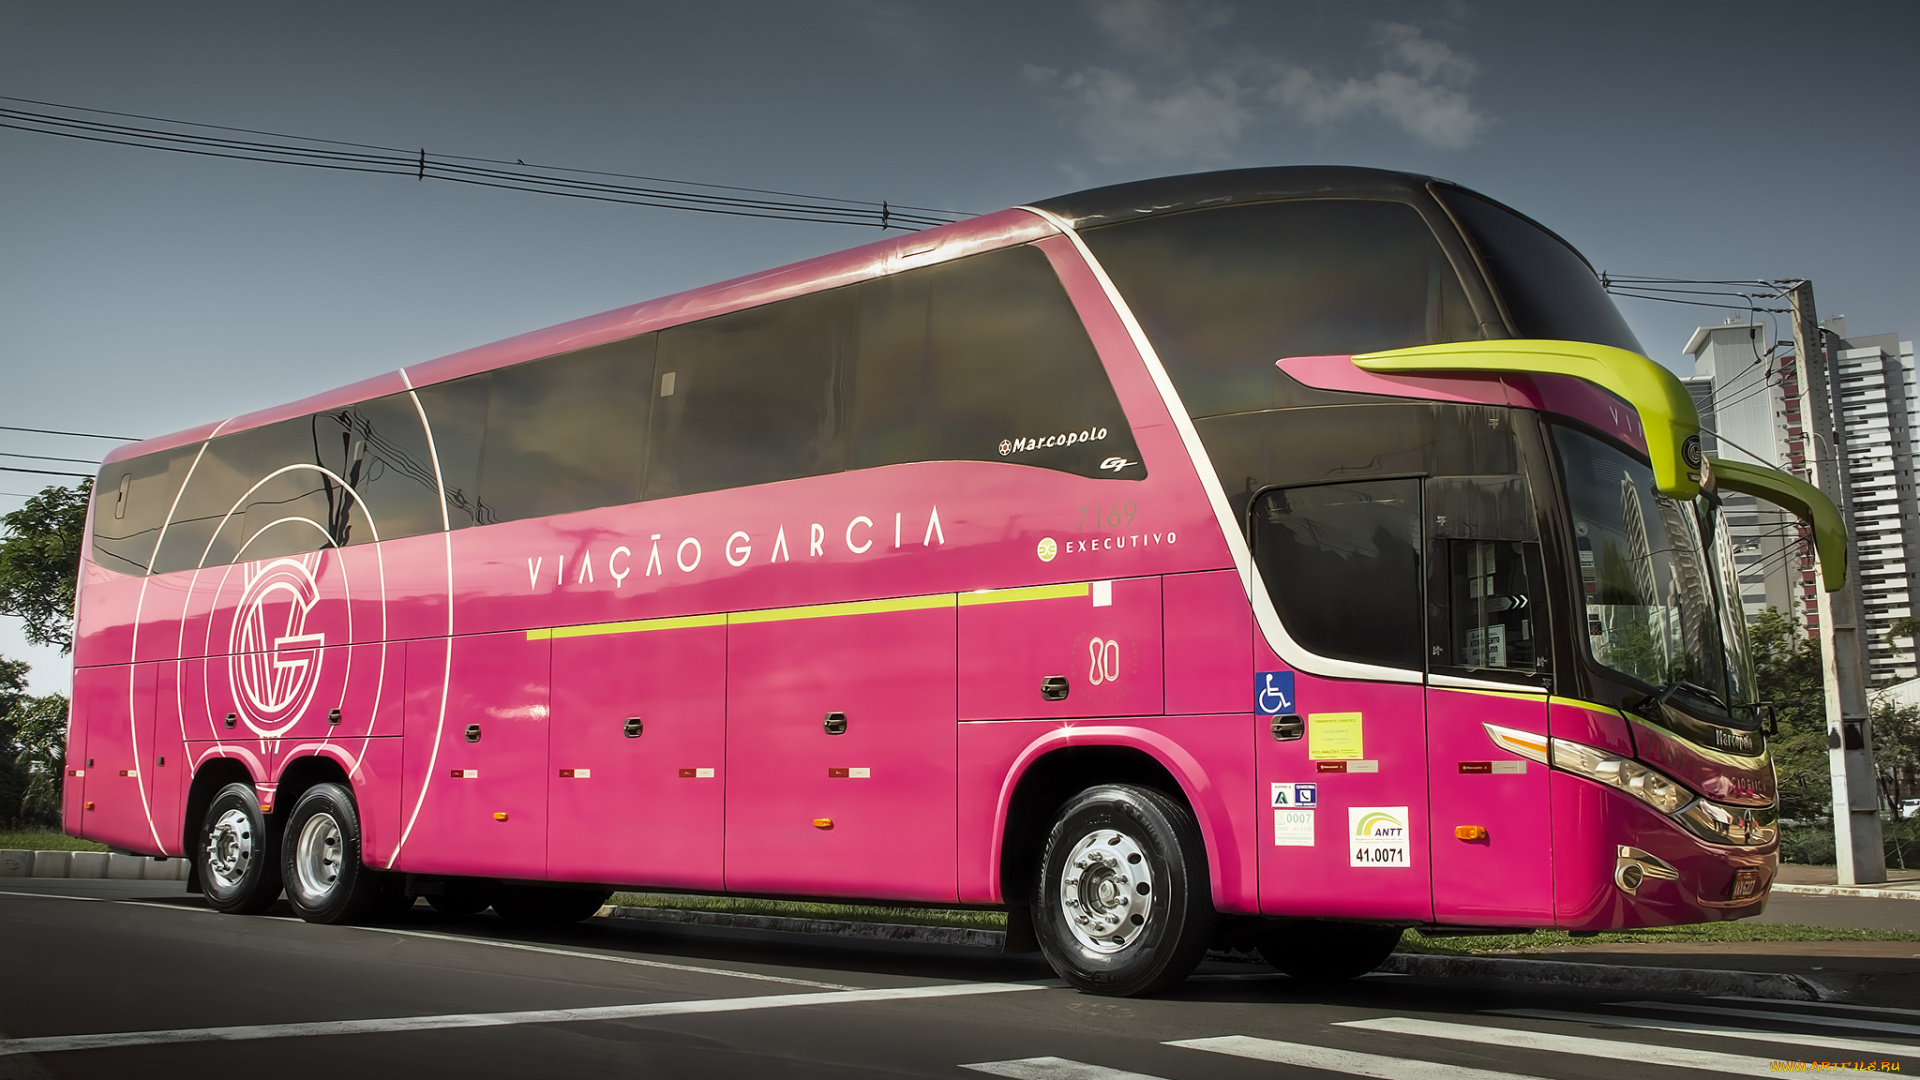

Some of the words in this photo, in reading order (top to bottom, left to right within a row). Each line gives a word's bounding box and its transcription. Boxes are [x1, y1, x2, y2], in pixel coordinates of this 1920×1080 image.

[1012, 426, 1107, 453] Marcopolo
[1076, 501, 1137, 532] 7169
[725, 504, 945, 567] GARCIA
[1065, 532, 1177, 553] EXECUTIVO
[1643, 732, 1684, 770] 7169
[1286, 813, 1312, 824] 0007
[1374, 828, 1403, 837] ANTT
[1356, 848, 1403, 862] 41.0071
